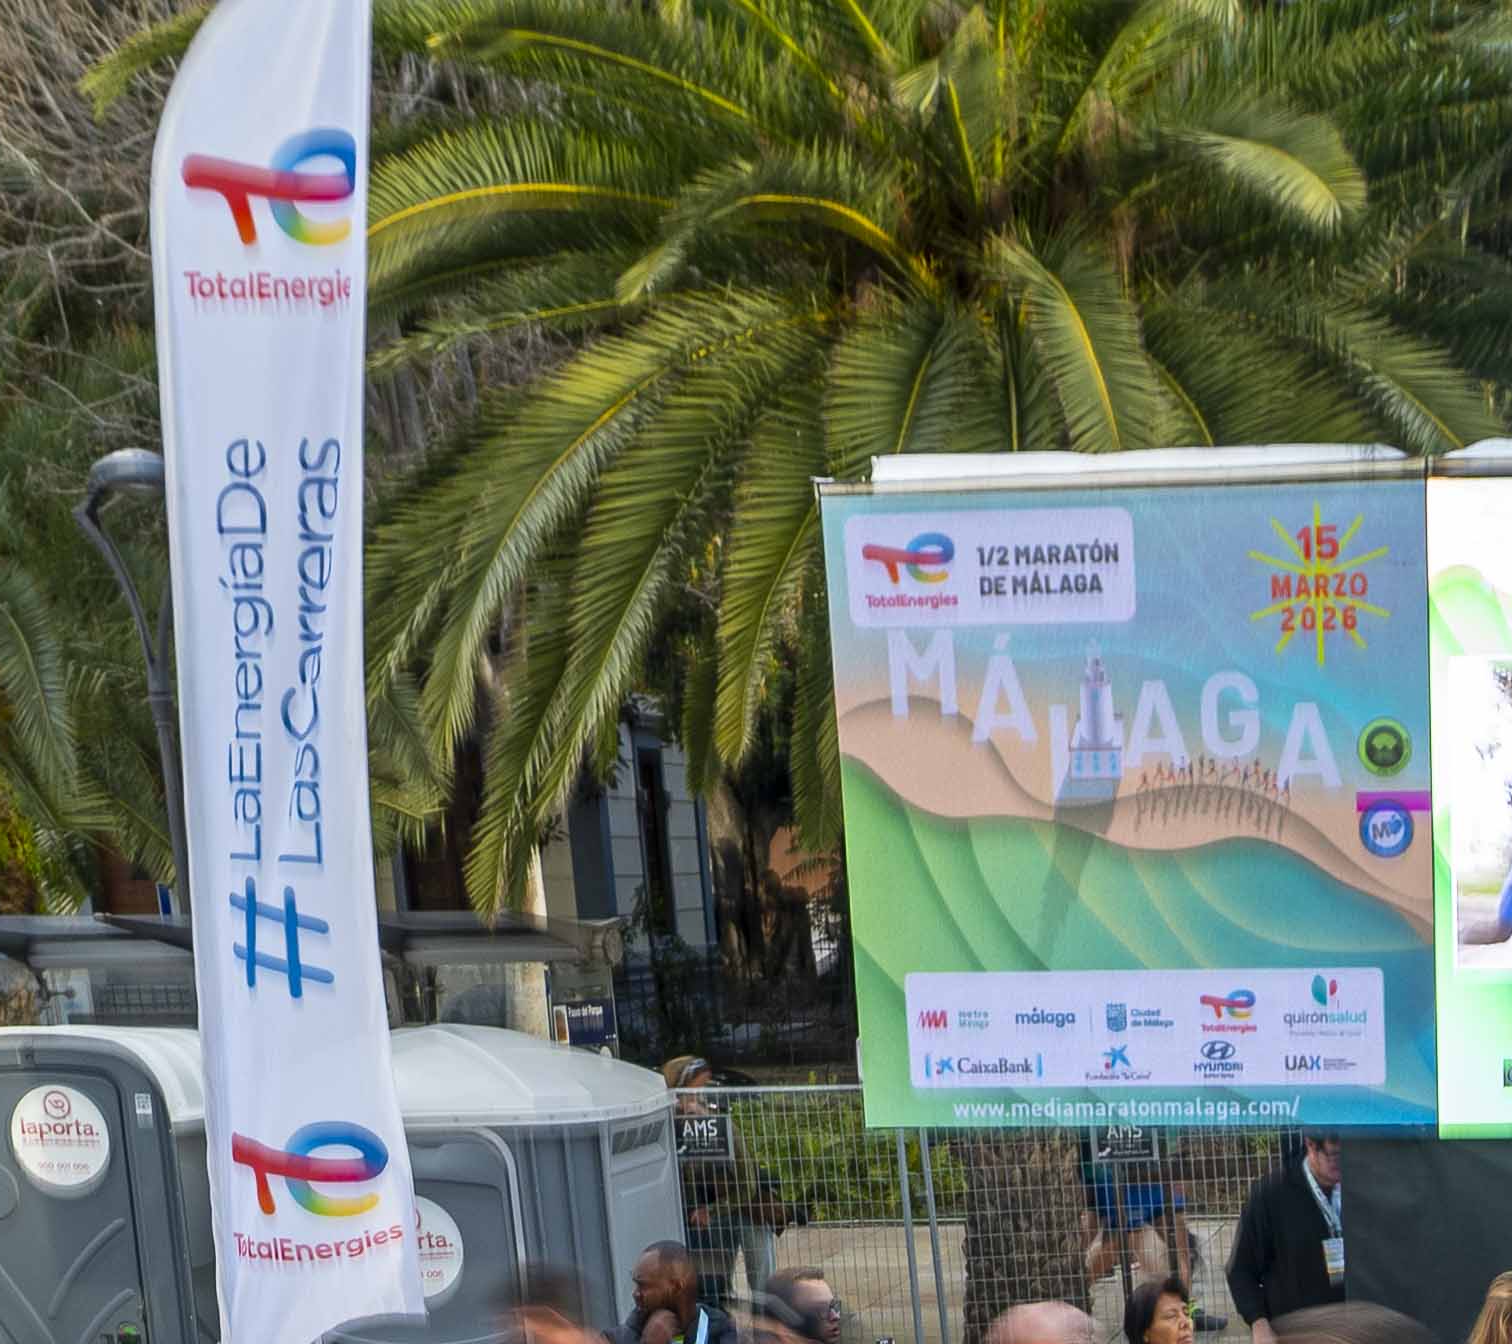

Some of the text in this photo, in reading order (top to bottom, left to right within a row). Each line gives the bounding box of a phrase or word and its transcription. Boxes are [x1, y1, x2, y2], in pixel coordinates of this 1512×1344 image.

[184, 271, 352, 306] TotalEnergie
[977, 538, 1120, 567] 1/2 MARATÓN
[1296, 524, 1340, 561] 15
[979, 571, 1103, 596] DE MÁLAGA
[1271, 572, 1368, 598] MARZO
[865, 593, 959, 609] TotalEnergies
[1280, 606, 1358, 632] 2026
[217, 438, 273, 862] LaEnergíaDe
[276, 437, 341, 864] LasCarreras
[1016, 1007, 1076, 1028] málaga
[1283, 1010, 1368, 1028] quirónsalud
[957, 1057, 1033, 1074] CaixaBank
[1194, 1062, 1244, 1073] HYUNDAI
[1285, 1055, 1321, 1071] UAX
[953, 1095, 1301, 1121] www.mediamaratonmalaga.com/
[683, 1119, 718, 1137] AMS
[233, 1223, 403, 1263] TotalEnergies
